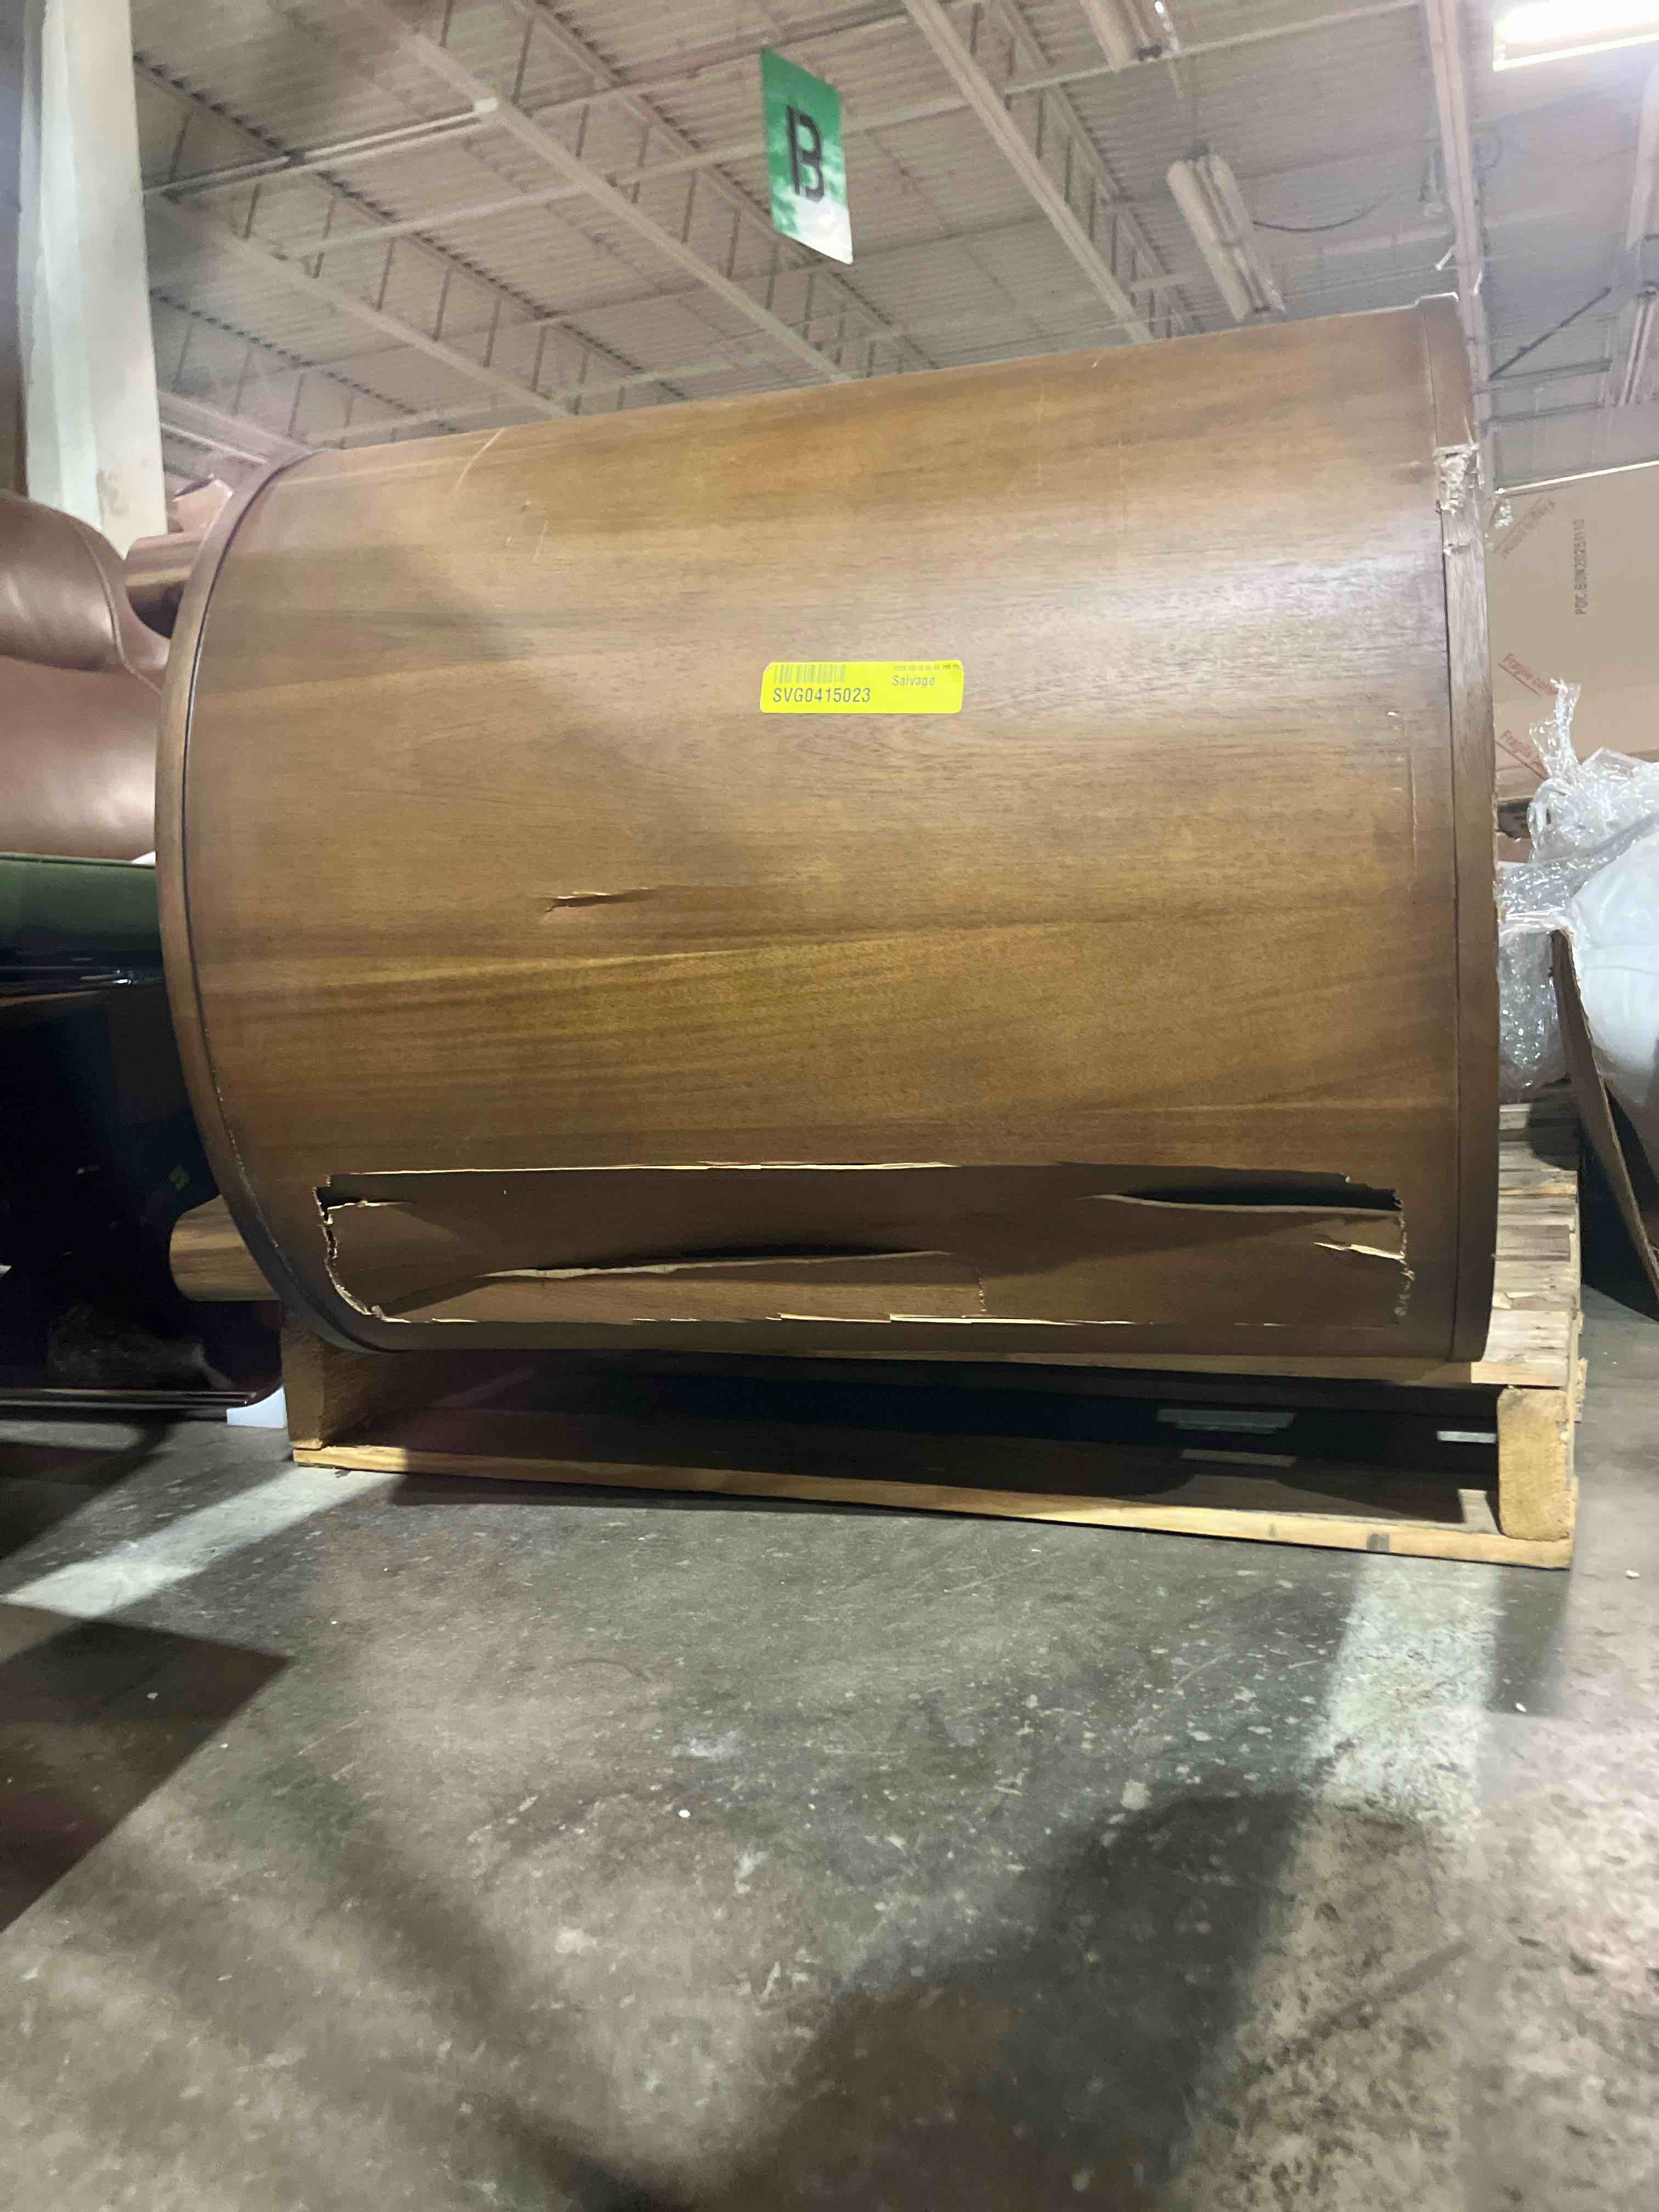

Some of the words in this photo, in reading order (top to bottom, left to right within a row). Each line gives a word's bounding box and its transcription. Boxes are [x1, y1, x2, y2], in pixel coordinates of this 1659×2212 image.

[786, 105, 825, 202] B
[892, 675, 935, 689] Salvage
[772, 687, 871, 703] SVG0415023
